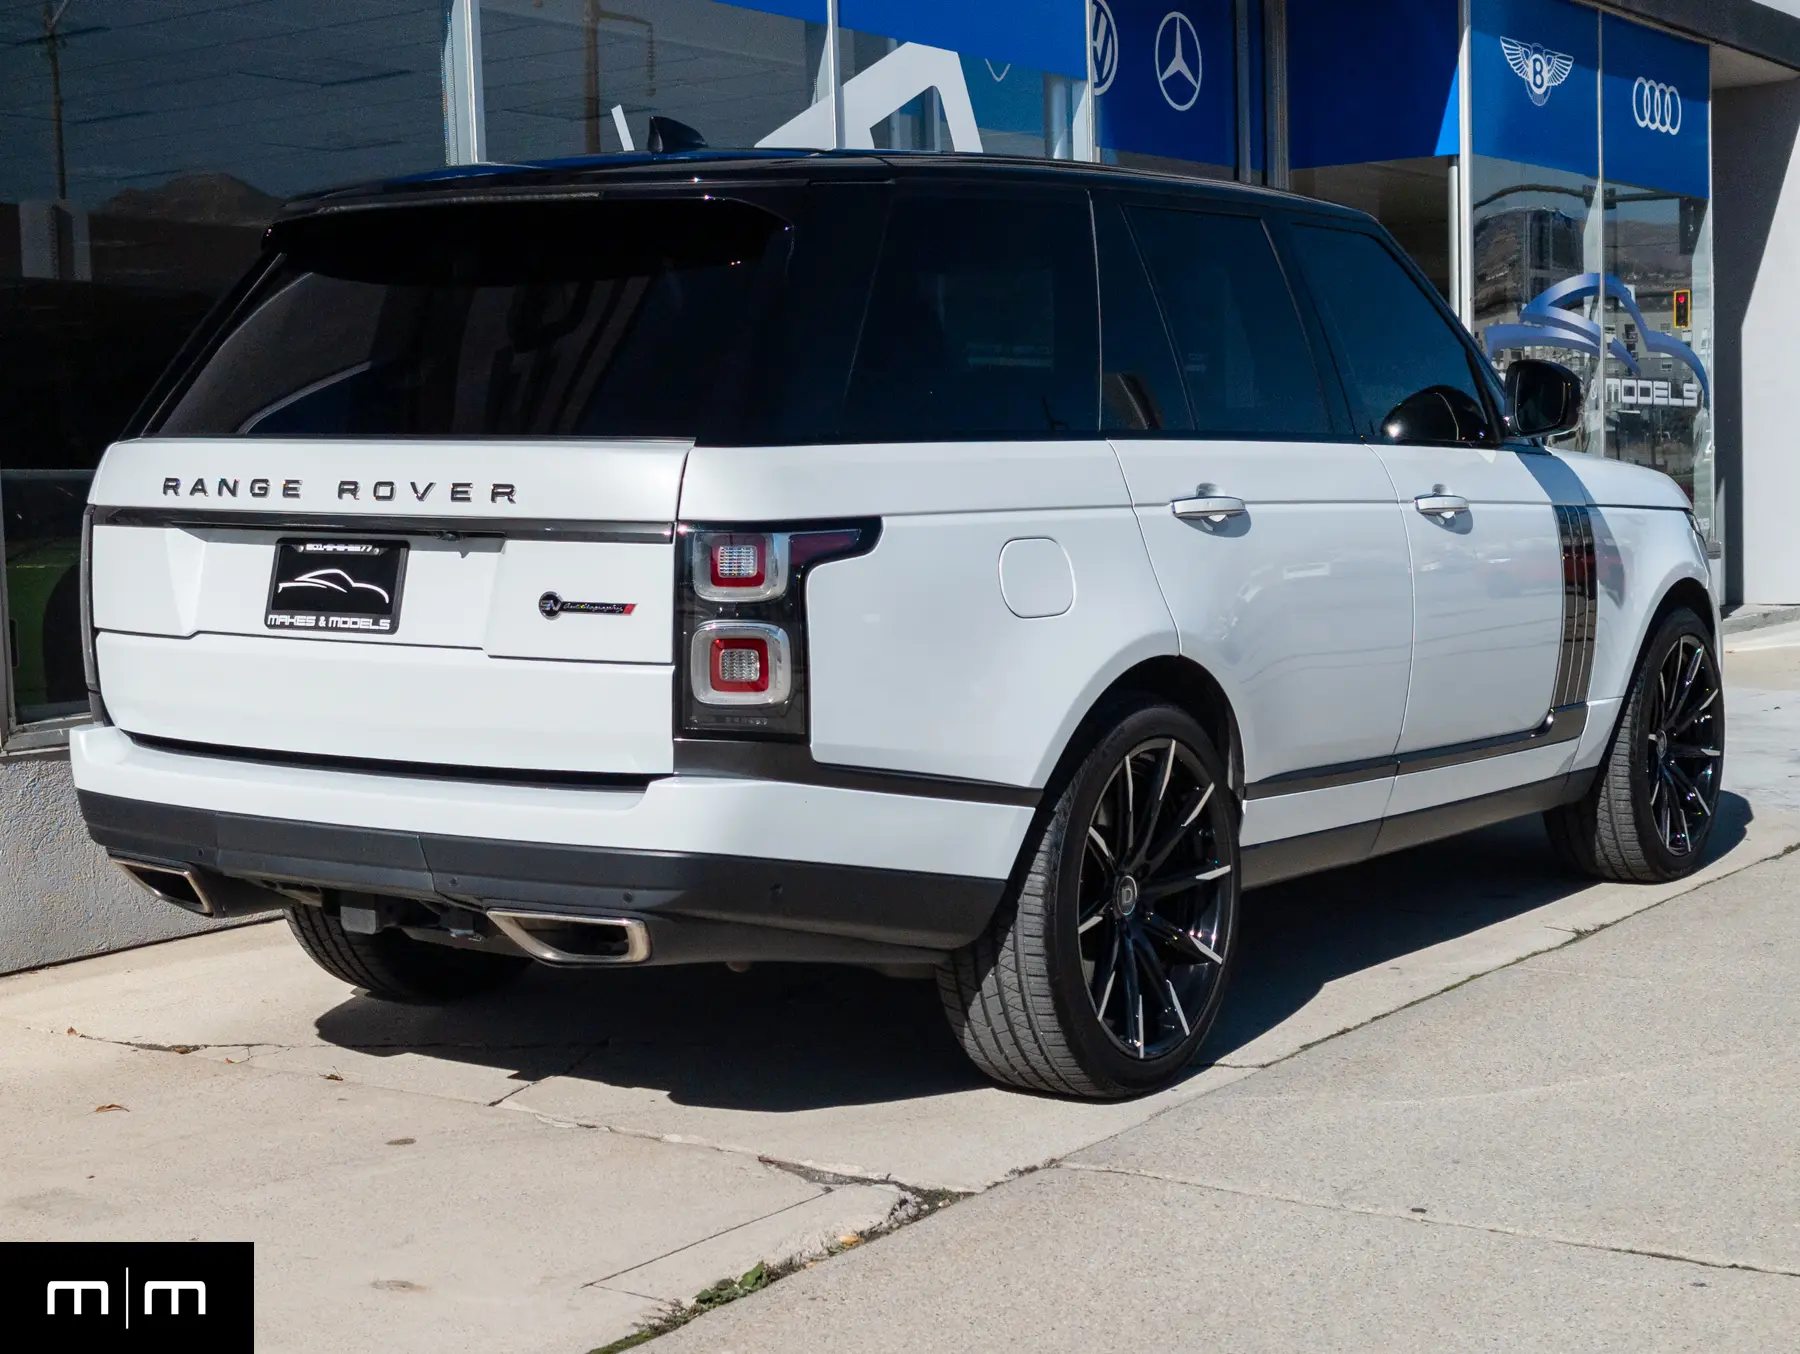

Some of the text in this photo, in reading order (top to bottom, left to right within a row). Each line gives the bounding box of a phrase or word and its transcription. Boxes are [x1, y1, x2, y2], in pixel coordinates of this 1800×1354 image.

[1605, 378, 1698, 407] MODELS
[162, 477, 516, 504] RANGE ROVER
[267, 614, 391, 630] MAKES & MODELS
